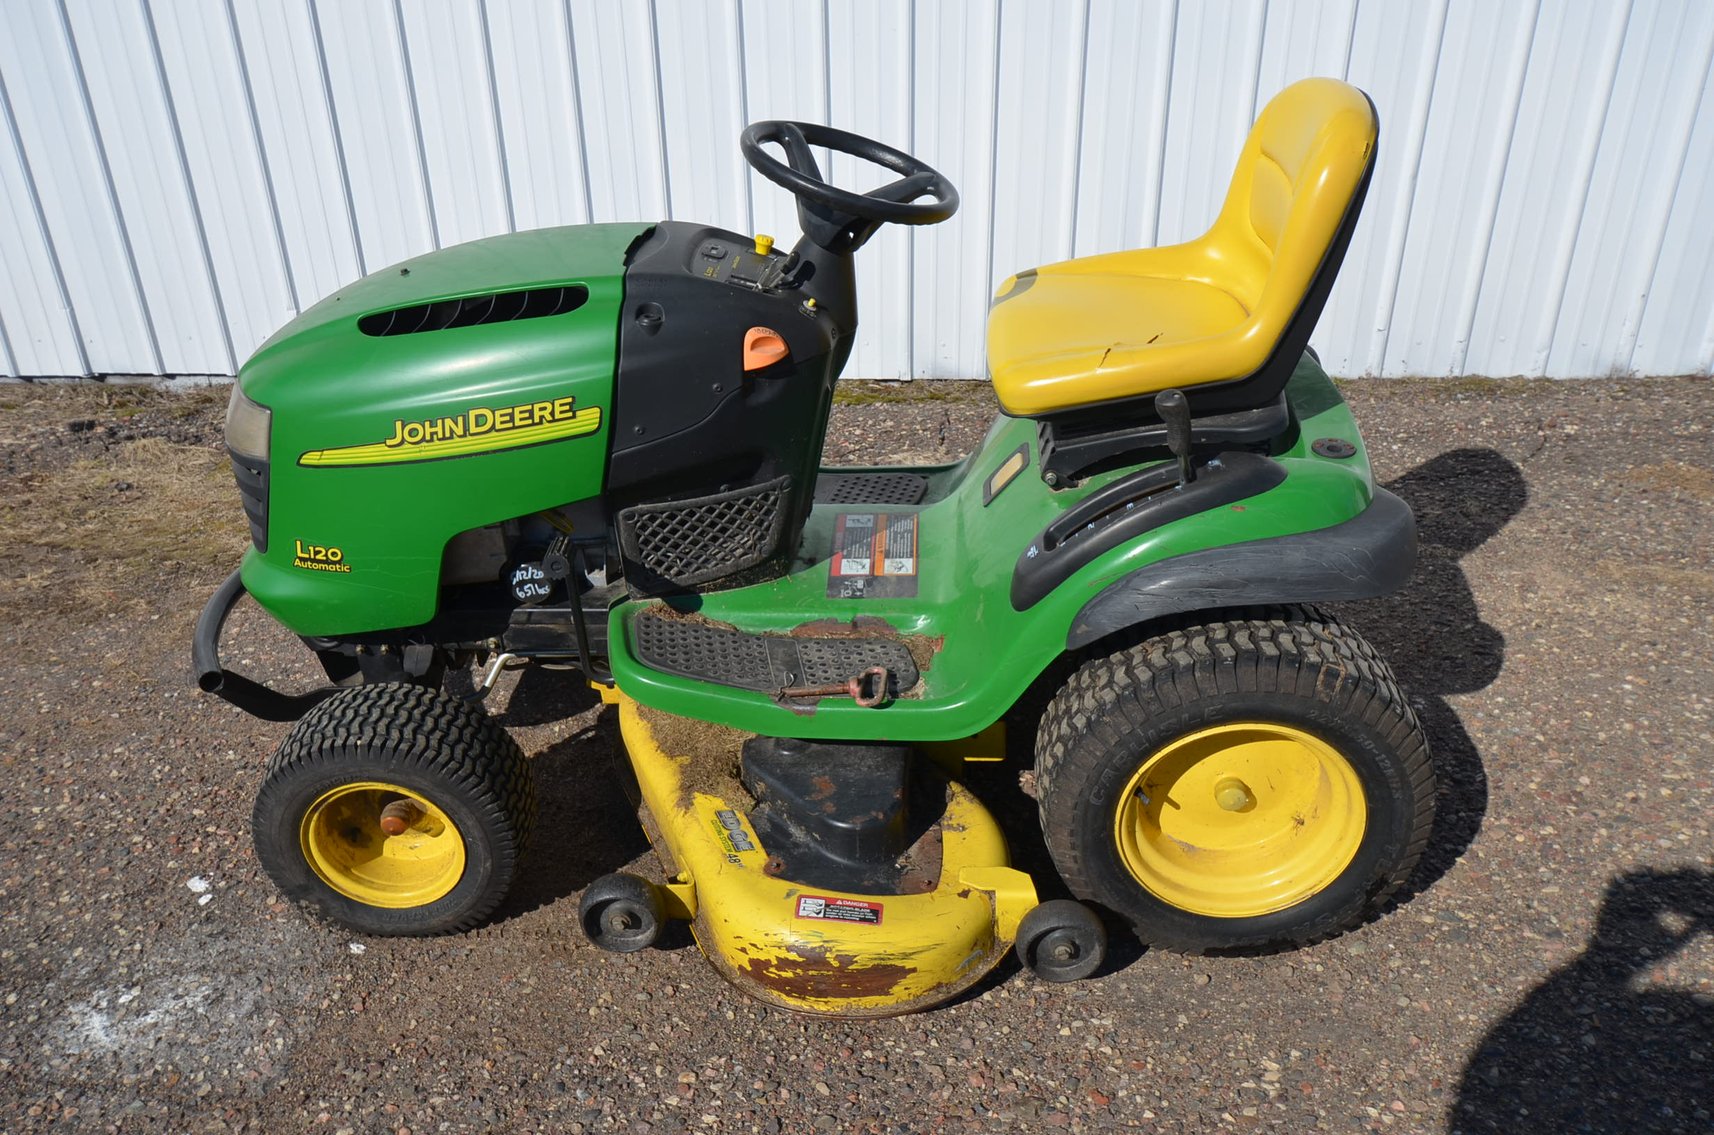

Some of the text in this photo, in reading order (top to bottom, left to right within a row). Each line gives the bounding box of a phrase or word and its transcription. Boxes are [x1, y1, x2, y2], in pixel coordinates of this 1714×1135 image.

[385, 396, 575, 446] JOHN DEERE
[295, 540, 342, 561] L120
[294, 558, 350, 572] Automatic
